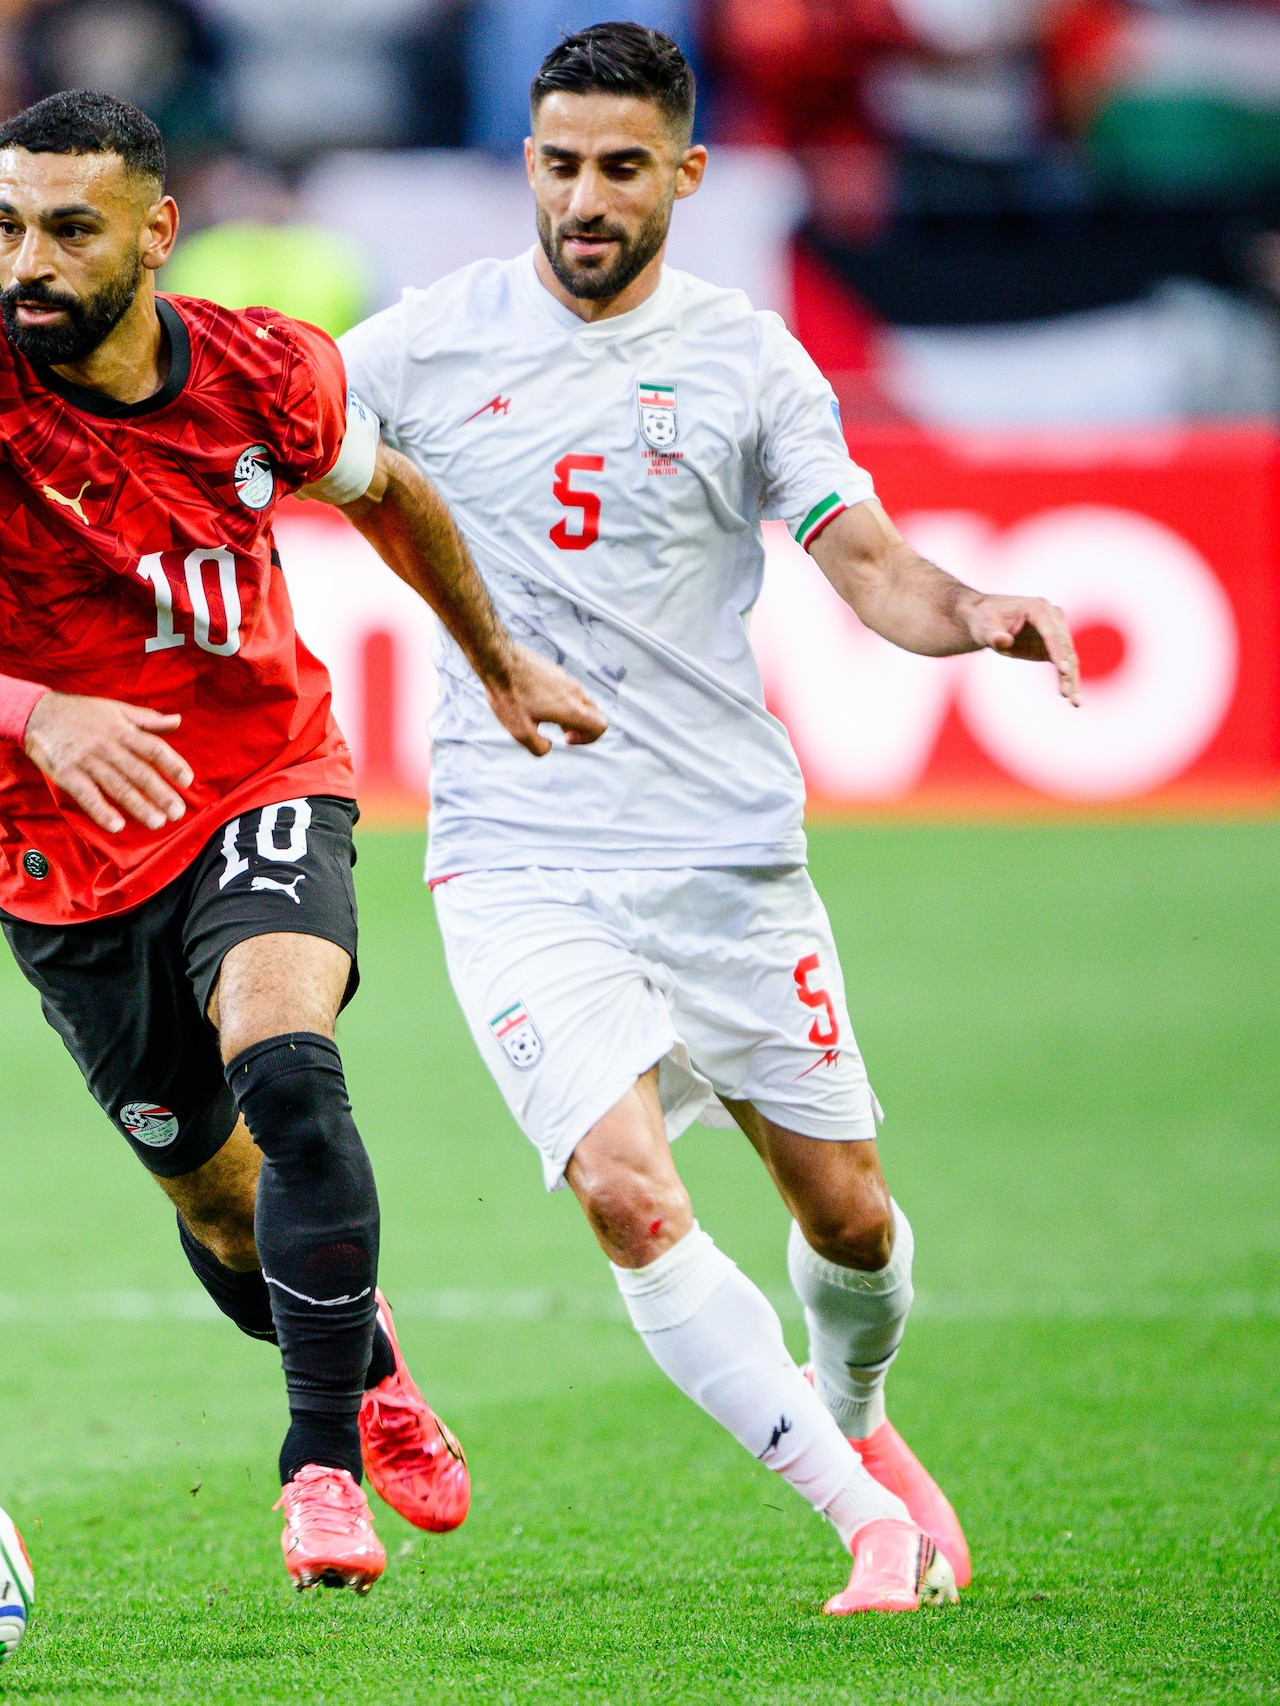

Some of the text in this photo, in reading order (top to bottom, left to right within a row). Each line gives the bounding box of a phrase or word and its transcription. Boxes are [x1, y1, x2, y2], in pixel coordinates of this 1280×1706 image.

[549, 452, 605, 550] 5
[135, 543, 242, 657] 10
[218, 796, 313, 891] 10
[793, 951, 839, 1048] 5
